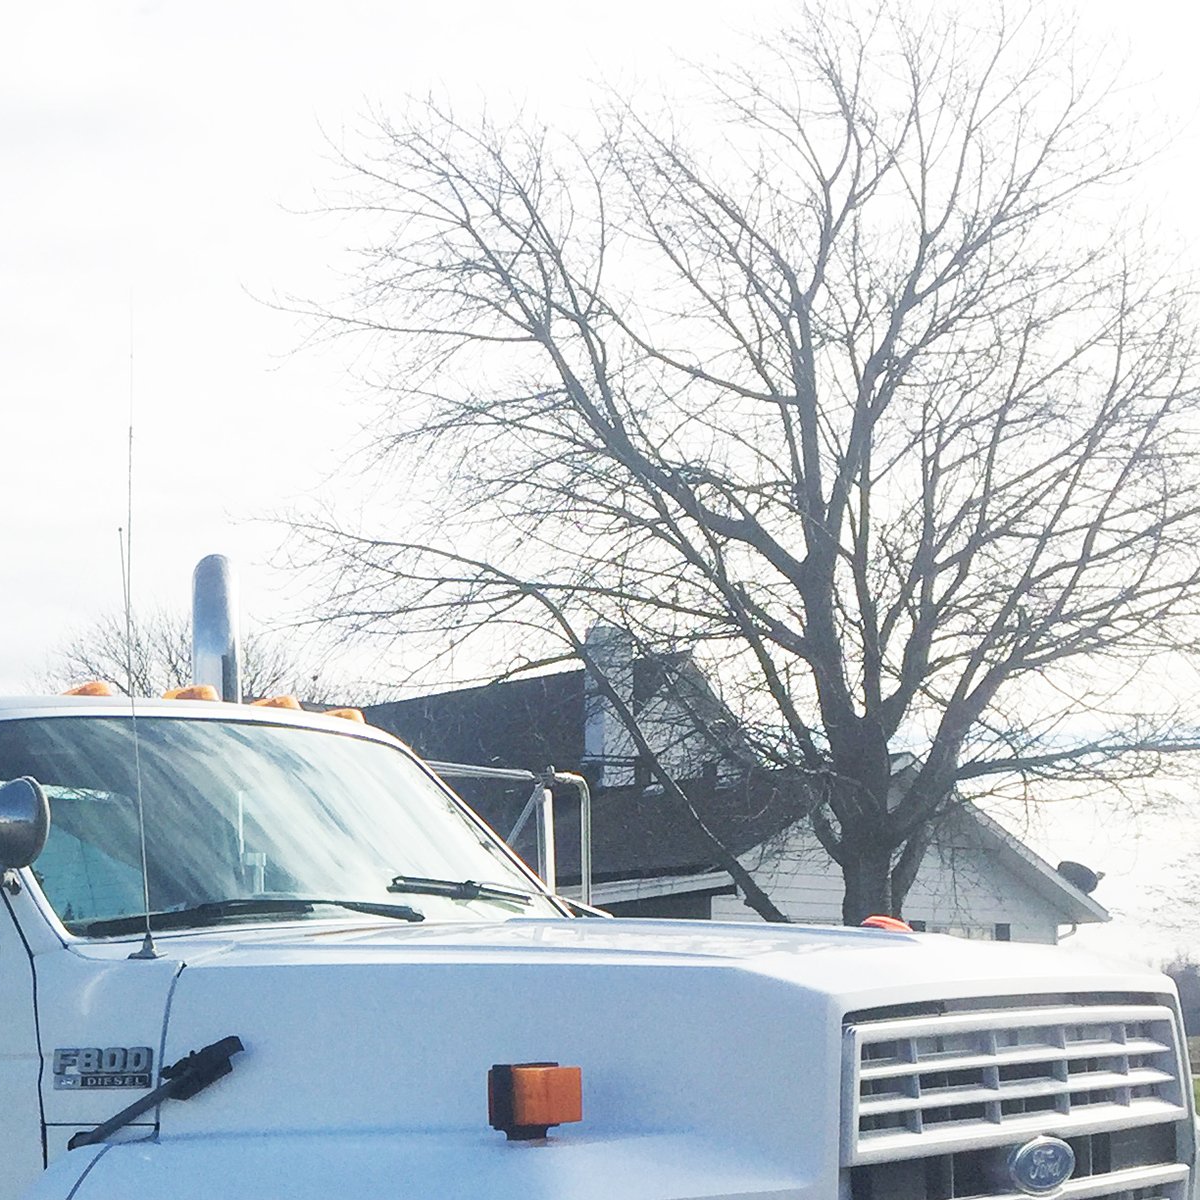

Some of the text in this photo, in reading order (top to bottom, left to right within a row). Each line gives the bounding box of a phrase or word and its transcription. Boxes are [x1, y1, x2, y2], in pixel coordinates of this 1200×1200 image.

[53, 1046, 153, 1075] F800
[86, 1076, 145, 1086] DIESEL
[1029, 1148, 1062, 1180] Ford
